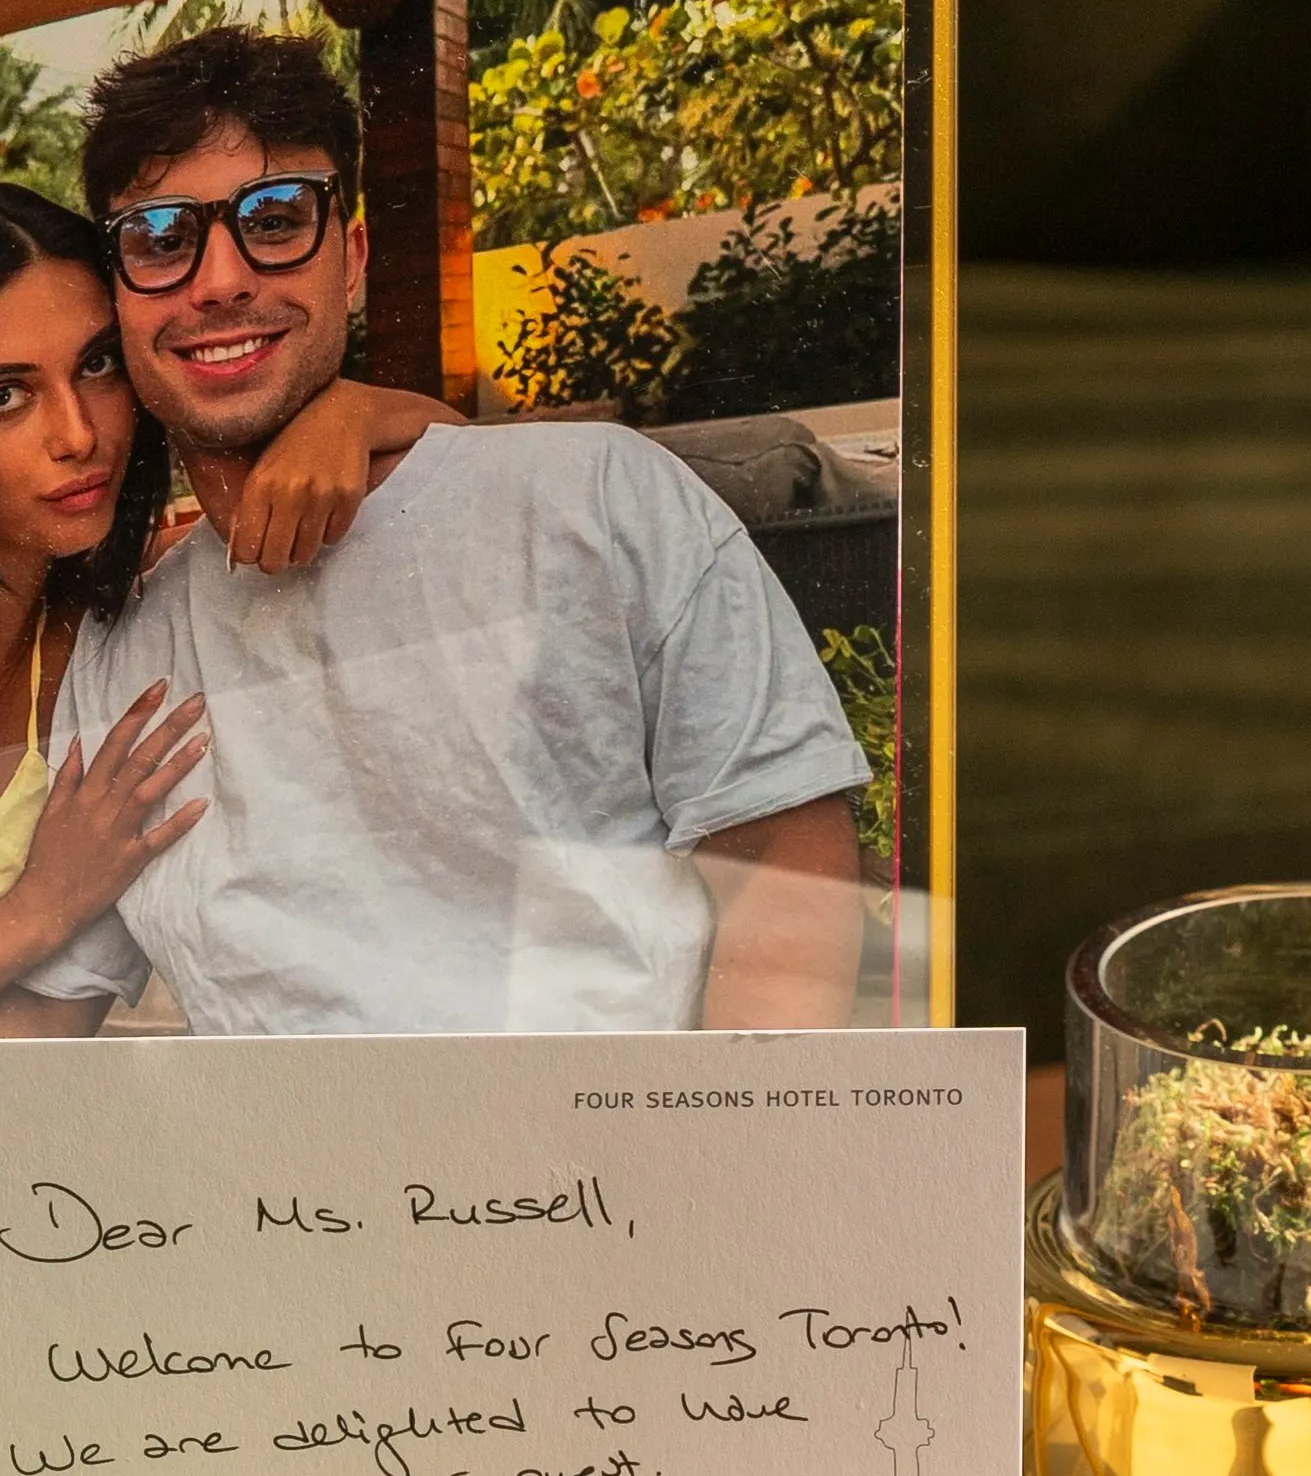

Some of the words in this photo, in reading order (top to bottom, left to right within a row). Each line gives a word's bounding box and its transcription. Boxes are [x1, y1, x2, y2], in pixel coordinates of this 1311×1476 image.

[574, 1091, 634, 1110] FOUR
[646, 1090, 754, 1109] SEASONS
[766, 1089, 840, 1108] HOTEL
[850, 1088, 963, 1107] TORONTO
[256, 1196, 363, 1234] Ms.
[403, 1175, 635, 1239] Russell,
[47, 1335, 294, 1383] Welcome
[339, 1323, 403, 1360] to
[445, 1319, 551, 1362] Four
[590, 1320, 757, 1366] Seasons
[778, 1295, 966, 1350] Toronto!
[9, 1437, 116, 1476] We
[143, 1431, 240, 1459] are
[573, 1395, 636, 1430] to
[680, 1392, 809, 1422] have
